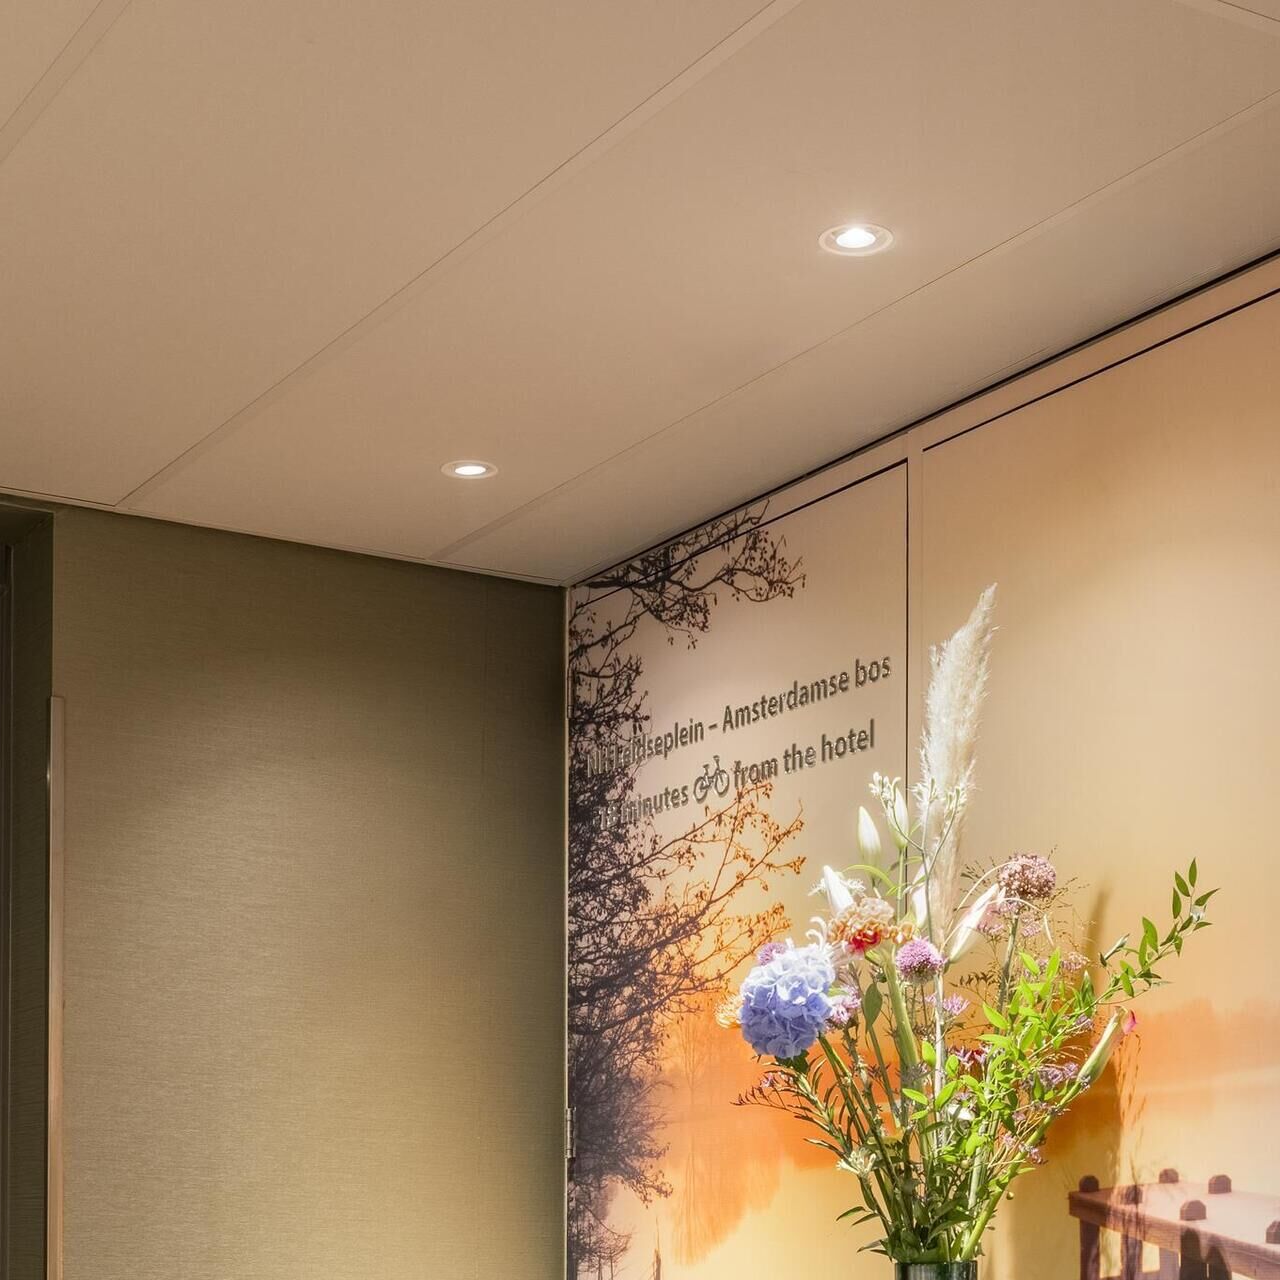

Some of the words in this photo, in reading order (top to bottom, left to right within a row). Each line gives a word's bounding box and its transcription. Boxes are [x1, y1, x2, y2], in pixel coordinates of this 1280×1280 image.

[722, 671, 849, 733] Amsterdamse
[855, 656, 891, 688] bos
[621, 784, 689, 823] minutes
[733, 757, 779, 788] from
[783, 743, 816, 774] the
[821, 718, 875, 763] hotel
